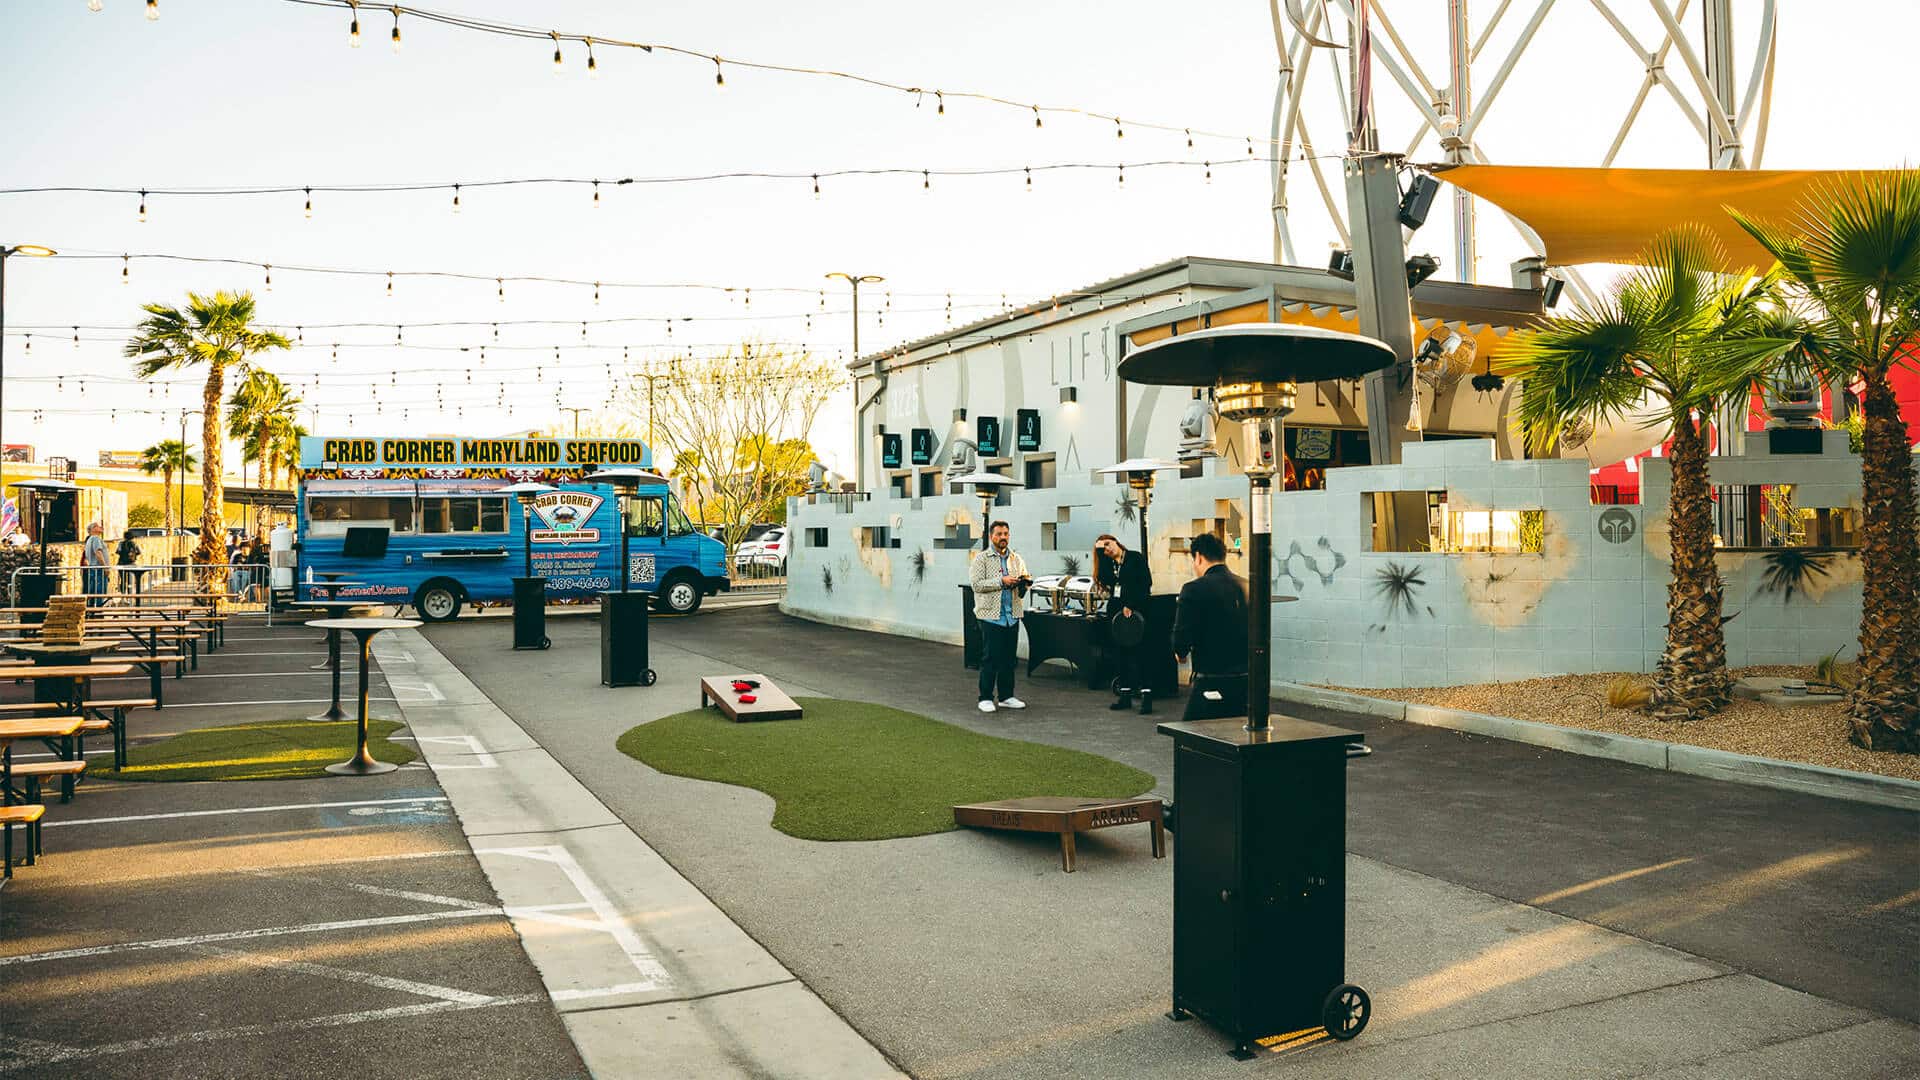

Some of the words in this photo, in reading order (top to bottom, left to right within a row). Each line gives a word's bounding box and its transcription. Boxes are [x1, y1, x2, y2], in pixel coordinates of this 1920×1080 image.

[325, 440, 377, 463] CRAB
[382, 439, 456, 463] CORNER
[461, 440, 560, 464] MARYLAND
[565, 441, 642, 464] SEAFOOD
[536, 496, 558, 508] CRAB
[560, 494, 593, 507] CORNER
[544, 577, 610, 590] -489-4646
